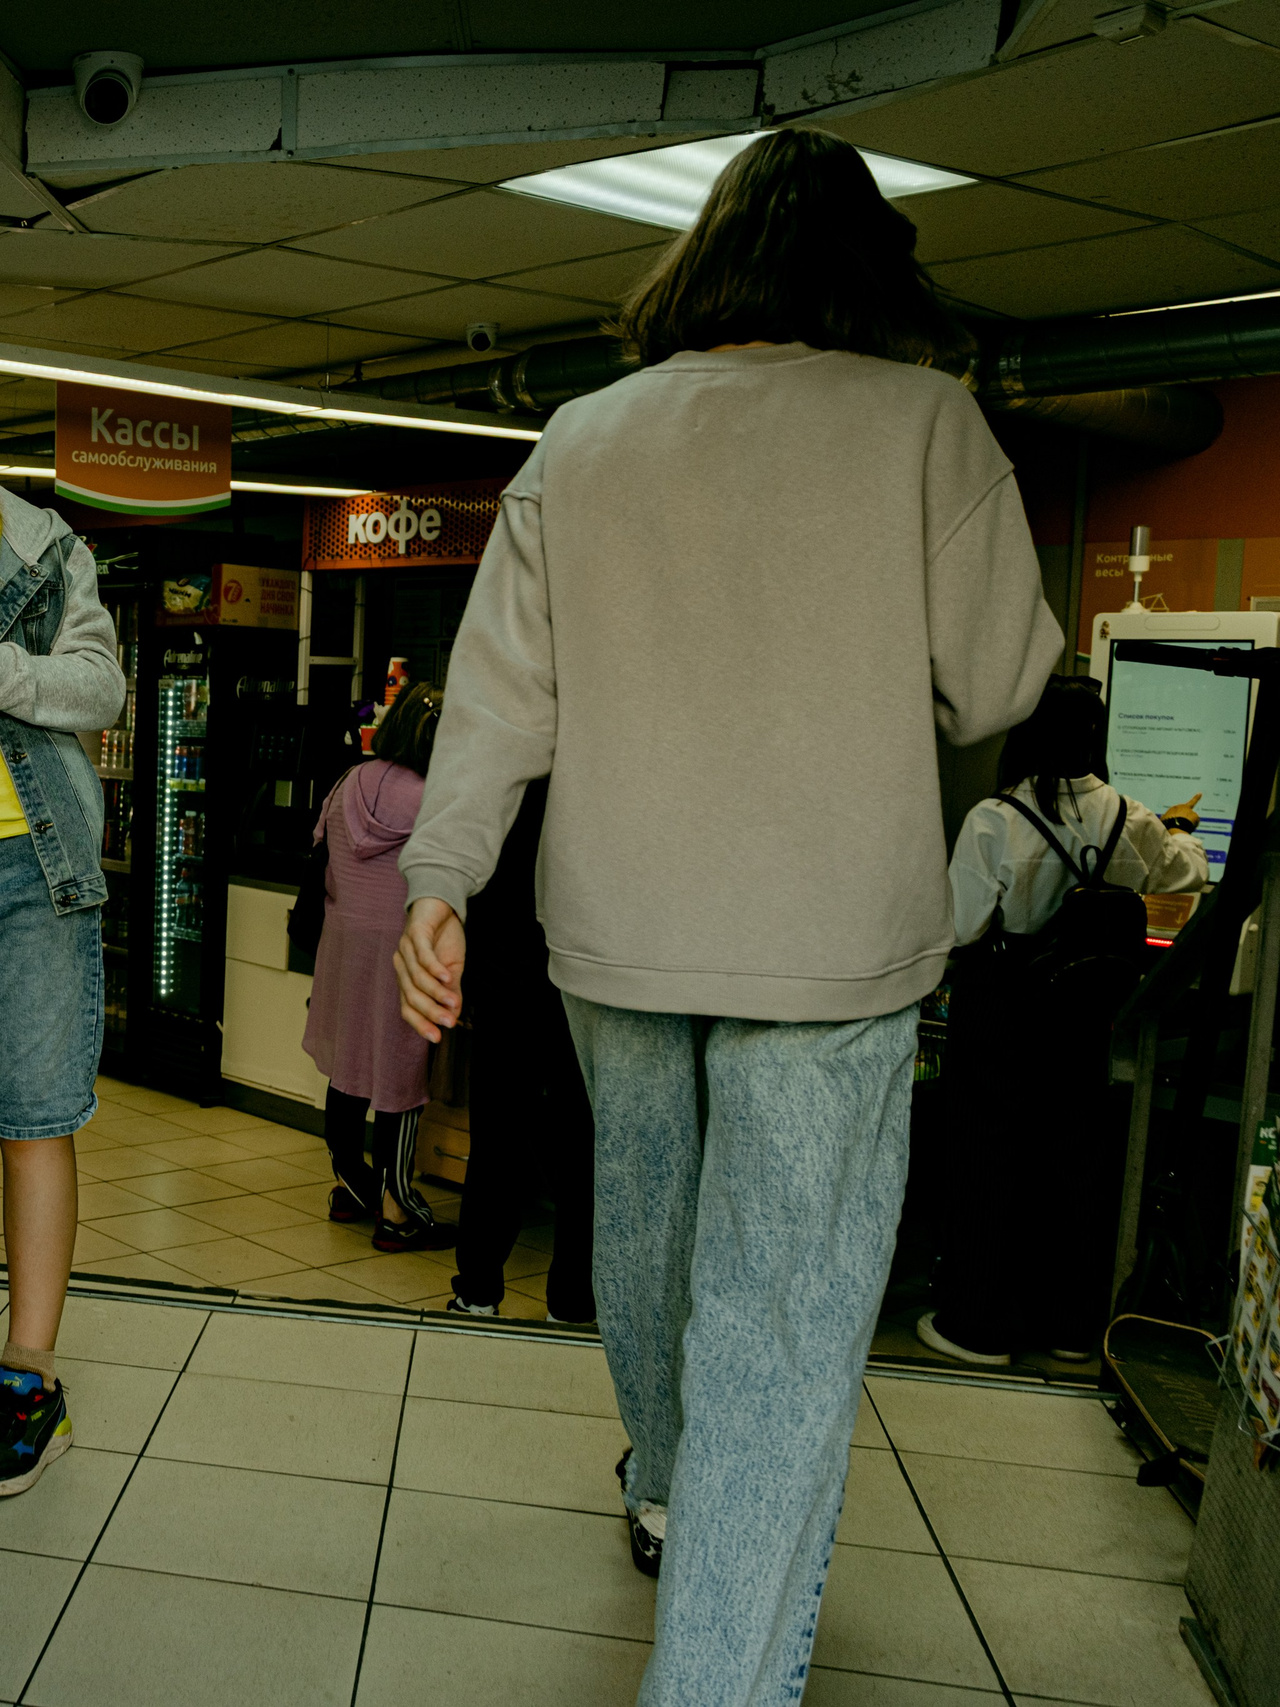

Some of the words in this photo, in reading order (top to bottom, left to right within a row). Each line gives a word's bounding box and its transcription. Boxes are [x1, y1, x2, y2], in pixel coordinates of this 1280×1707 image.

[91, 407, 199, 451] Кассы
[71, 450, 217, 474] самообслуживания
[347, 497, 442, 554] кофе
[1096, 553, 1174, 565] Контрные
[1095, 569, 1124, 578] весы
[163, 648, 204, 669] Adrenaline
[1118, 712, 1144, 720] Список
[1145, 714, 1174, 722] покупок
